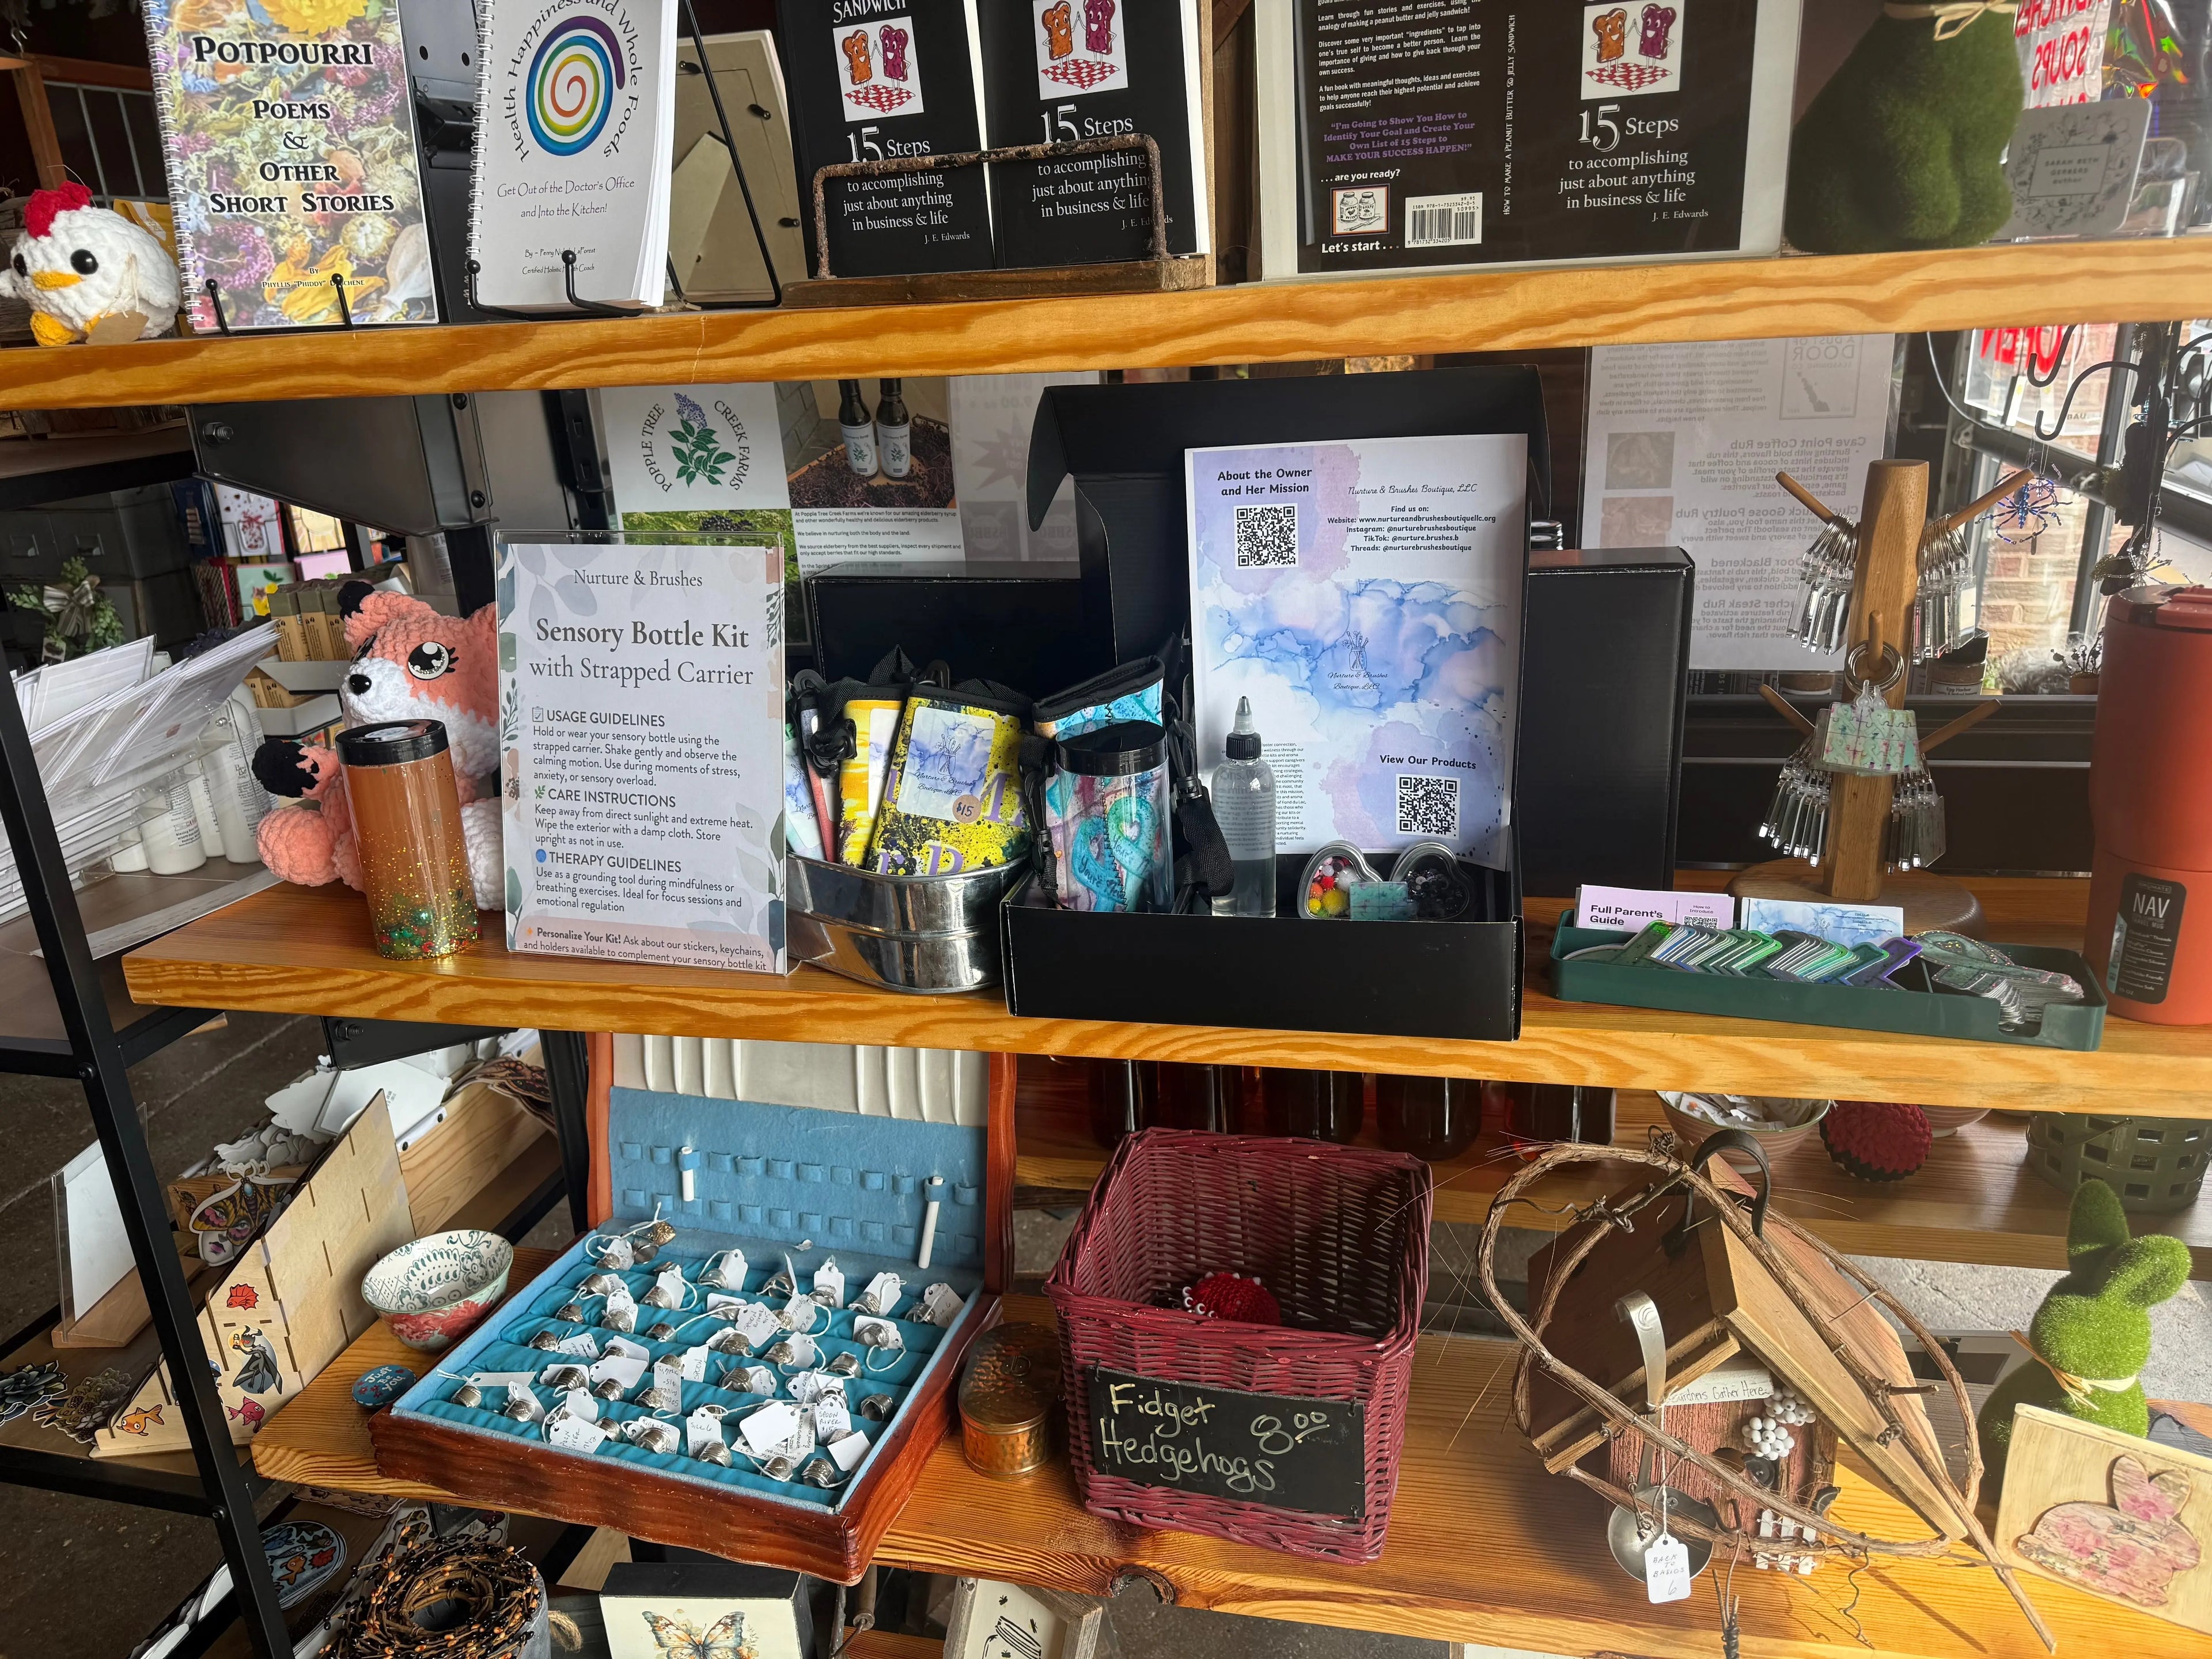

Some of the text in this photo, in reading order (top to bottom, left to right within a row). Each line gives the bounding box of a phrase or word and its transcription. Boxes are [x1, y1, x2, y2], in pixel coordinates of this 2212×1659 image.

[618, 8, 643, 86] Whole
[1506, 90, 1514, 120] BUTTER
[503, 85, 529, 162] Health
[603, 94, 639, 158] Foods
[1578, 104, 1679, 152] 15 Steps
[283, 132, 309, 149] &
[847, 126, 930, 163] 15 Steps
[1505, 123, 1513, 153] PEANUT
[1569, 150, 1688, 170] to accomplishing
[847, 172, 944, 192] to accomplishing
[1351, 173, 1368, 182] you
[1370, 169, 1400, 179] ready?
[1558, 169, 1695, 194] just about anything
[498, 176, 635, 197] Get Out of the Doctor's Office
[843, 191, 953, 216] just about anything
[1567, 188, 1687, 208] in business & life
[521, 202, 607, 218] and Into the Kitchen!
[852, 210, 949, 230] in business & life
[925, 234, 929, 244] J.
[941, 232, 970, 240] Edwards
[1321, 241, 1380, 253] Let's start
[642, 400, 750, 493] POPPLE TREE CREEK FARMS
[1217, 467, 1312, 481] About the Owner
[1221, 483, 1309, 495] and Her Mission
[1348, 486, 1378, 495] Nurture
[1388, 486, 1418, 494] Brushes
[1421, 484, 1455, 495] Boutique,
[1457, 484, 1478, 493] LLC
[1346, 525, 1476, 535] Instagram: @nurturebrushesboutique
[1392, 535, 1459, 543] @nurture.brushes.b
[574, 570, 702, 586] Nurture & Brushes
[536, 618, 749, 652] Sensory Bottle Kit
[529, 655, 753, 688] with Strapped Carrier
[547, 710, 665, 727] USAGE GUIDELINES
[1380, 755, 1476, 770] View Our Products
[548, 789, 676, 808] CARE INSTRUCTIONS
[957, 802, 974, 817] $15
[549, 852, 681, 873] THERAPY GUIDELINES
[1591, 905, 1662, 918] Full Parent's
[2133, 893, 2170, 918] NAV
[1590, 916, 1624, 926] Guide
[537, 927, 621, 944] Personalize Your Kit!
[365, 1366, 392, 1383] Just
[1109, 1384, 1215, 1437] Fidget
[1100, 1418, 1275, 1493] Hedgehogs
